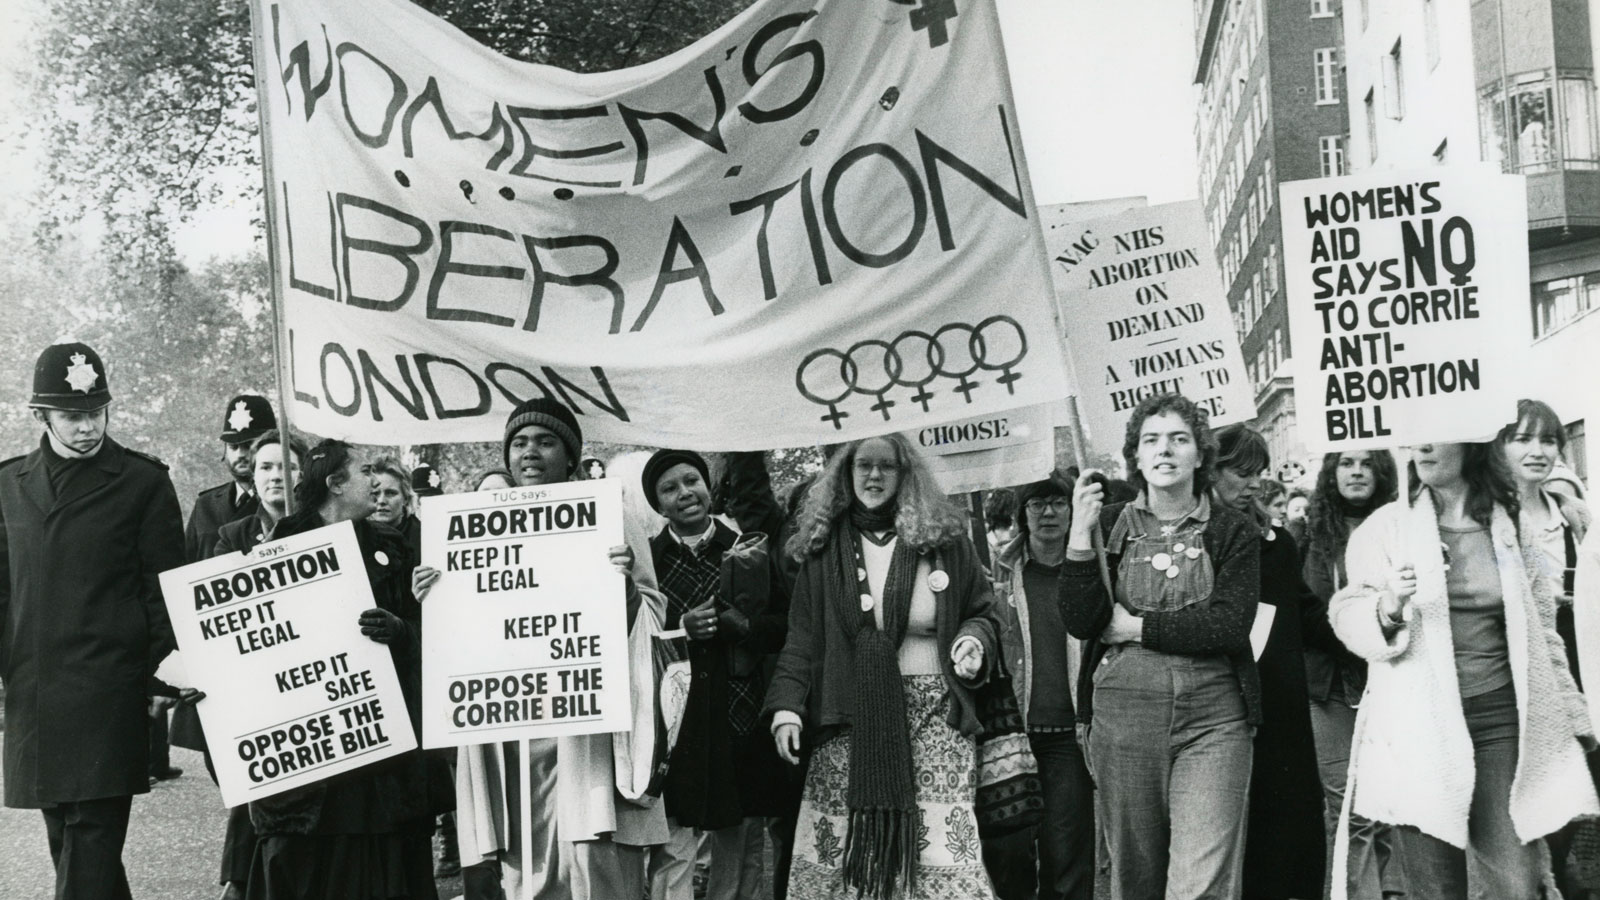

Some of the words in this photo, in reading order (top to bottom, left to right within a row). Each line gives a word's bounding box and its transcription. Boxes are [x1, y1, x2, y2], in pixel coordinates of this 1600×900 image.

[272, 3, 825, 187] WOMEN'S
[283, 104, 1026, 334] LIBERATION
[1303, 181, 1442, 229] WOMEN'S
[1055, 229, 1100, 274] NAC
[1113, 226, 1165, 254] NHS
[1310, 227, 1361, 263] AID
[1312, 258, 1400, 299] SAYS
[1401, 216, 1476, 288] NO
[1088, 248, 1200, 290] ABORTION
[1135, 282, 1169, 306] ON
[1314, 300, 1359, 333] TO
[1368, 286, 1480, 328] CORRIE
[1107, 302, 1205, 342] DEMAND
[1105, 365, 1121, 386] A
[1130, 340, 1226, 378] WOMANS
[1320, 332, 1404, 371] ANTI-
[289, 328, 630, 422] LONDON
[1200, 367, 1230, 390] TO
[1325, 359, 1480, 406] ABORTION
[918, 418, 1010, 447] CHOOSE
[1325, 405, 1392, 442] BILL
[492, 490, 518, 502] TUC
[447, 501, 597, 541] ABORTION
[258, 544, 289, 558] says:
[447, 547, 499, 572] KEEP
[504, 544, 524, 566] IT
[193, 547, 341, 612] ABORTION
[476, 567, 540, 593] LEGAL
[199, 607, 252, 641] KEEP
[255, 600, 276, 624] IT
[235, 620, 300, 655] LEGAL
[504, 615, 557, 640] KEEP
[562, 612, 582, 635] IT
[550, 635, 602, 660] SAFE
[274, 661, 326, 693] KEEP
[329, 652, 350, 677] IT
[324, 669, 376, 702] SAFE
[448, 673, 548, 703] OPPOSE
[558, 667, 603, 693] THE
[237, 714, 335, 762] OPPOSE
[338, 698, 385, 729] THE
[452, 697, 543, 728] CORRIE
[551, 693, 602, 719] BILL
[247, 738, 336, 784] CORRIE
[340, 722, 390, 755] BILL
